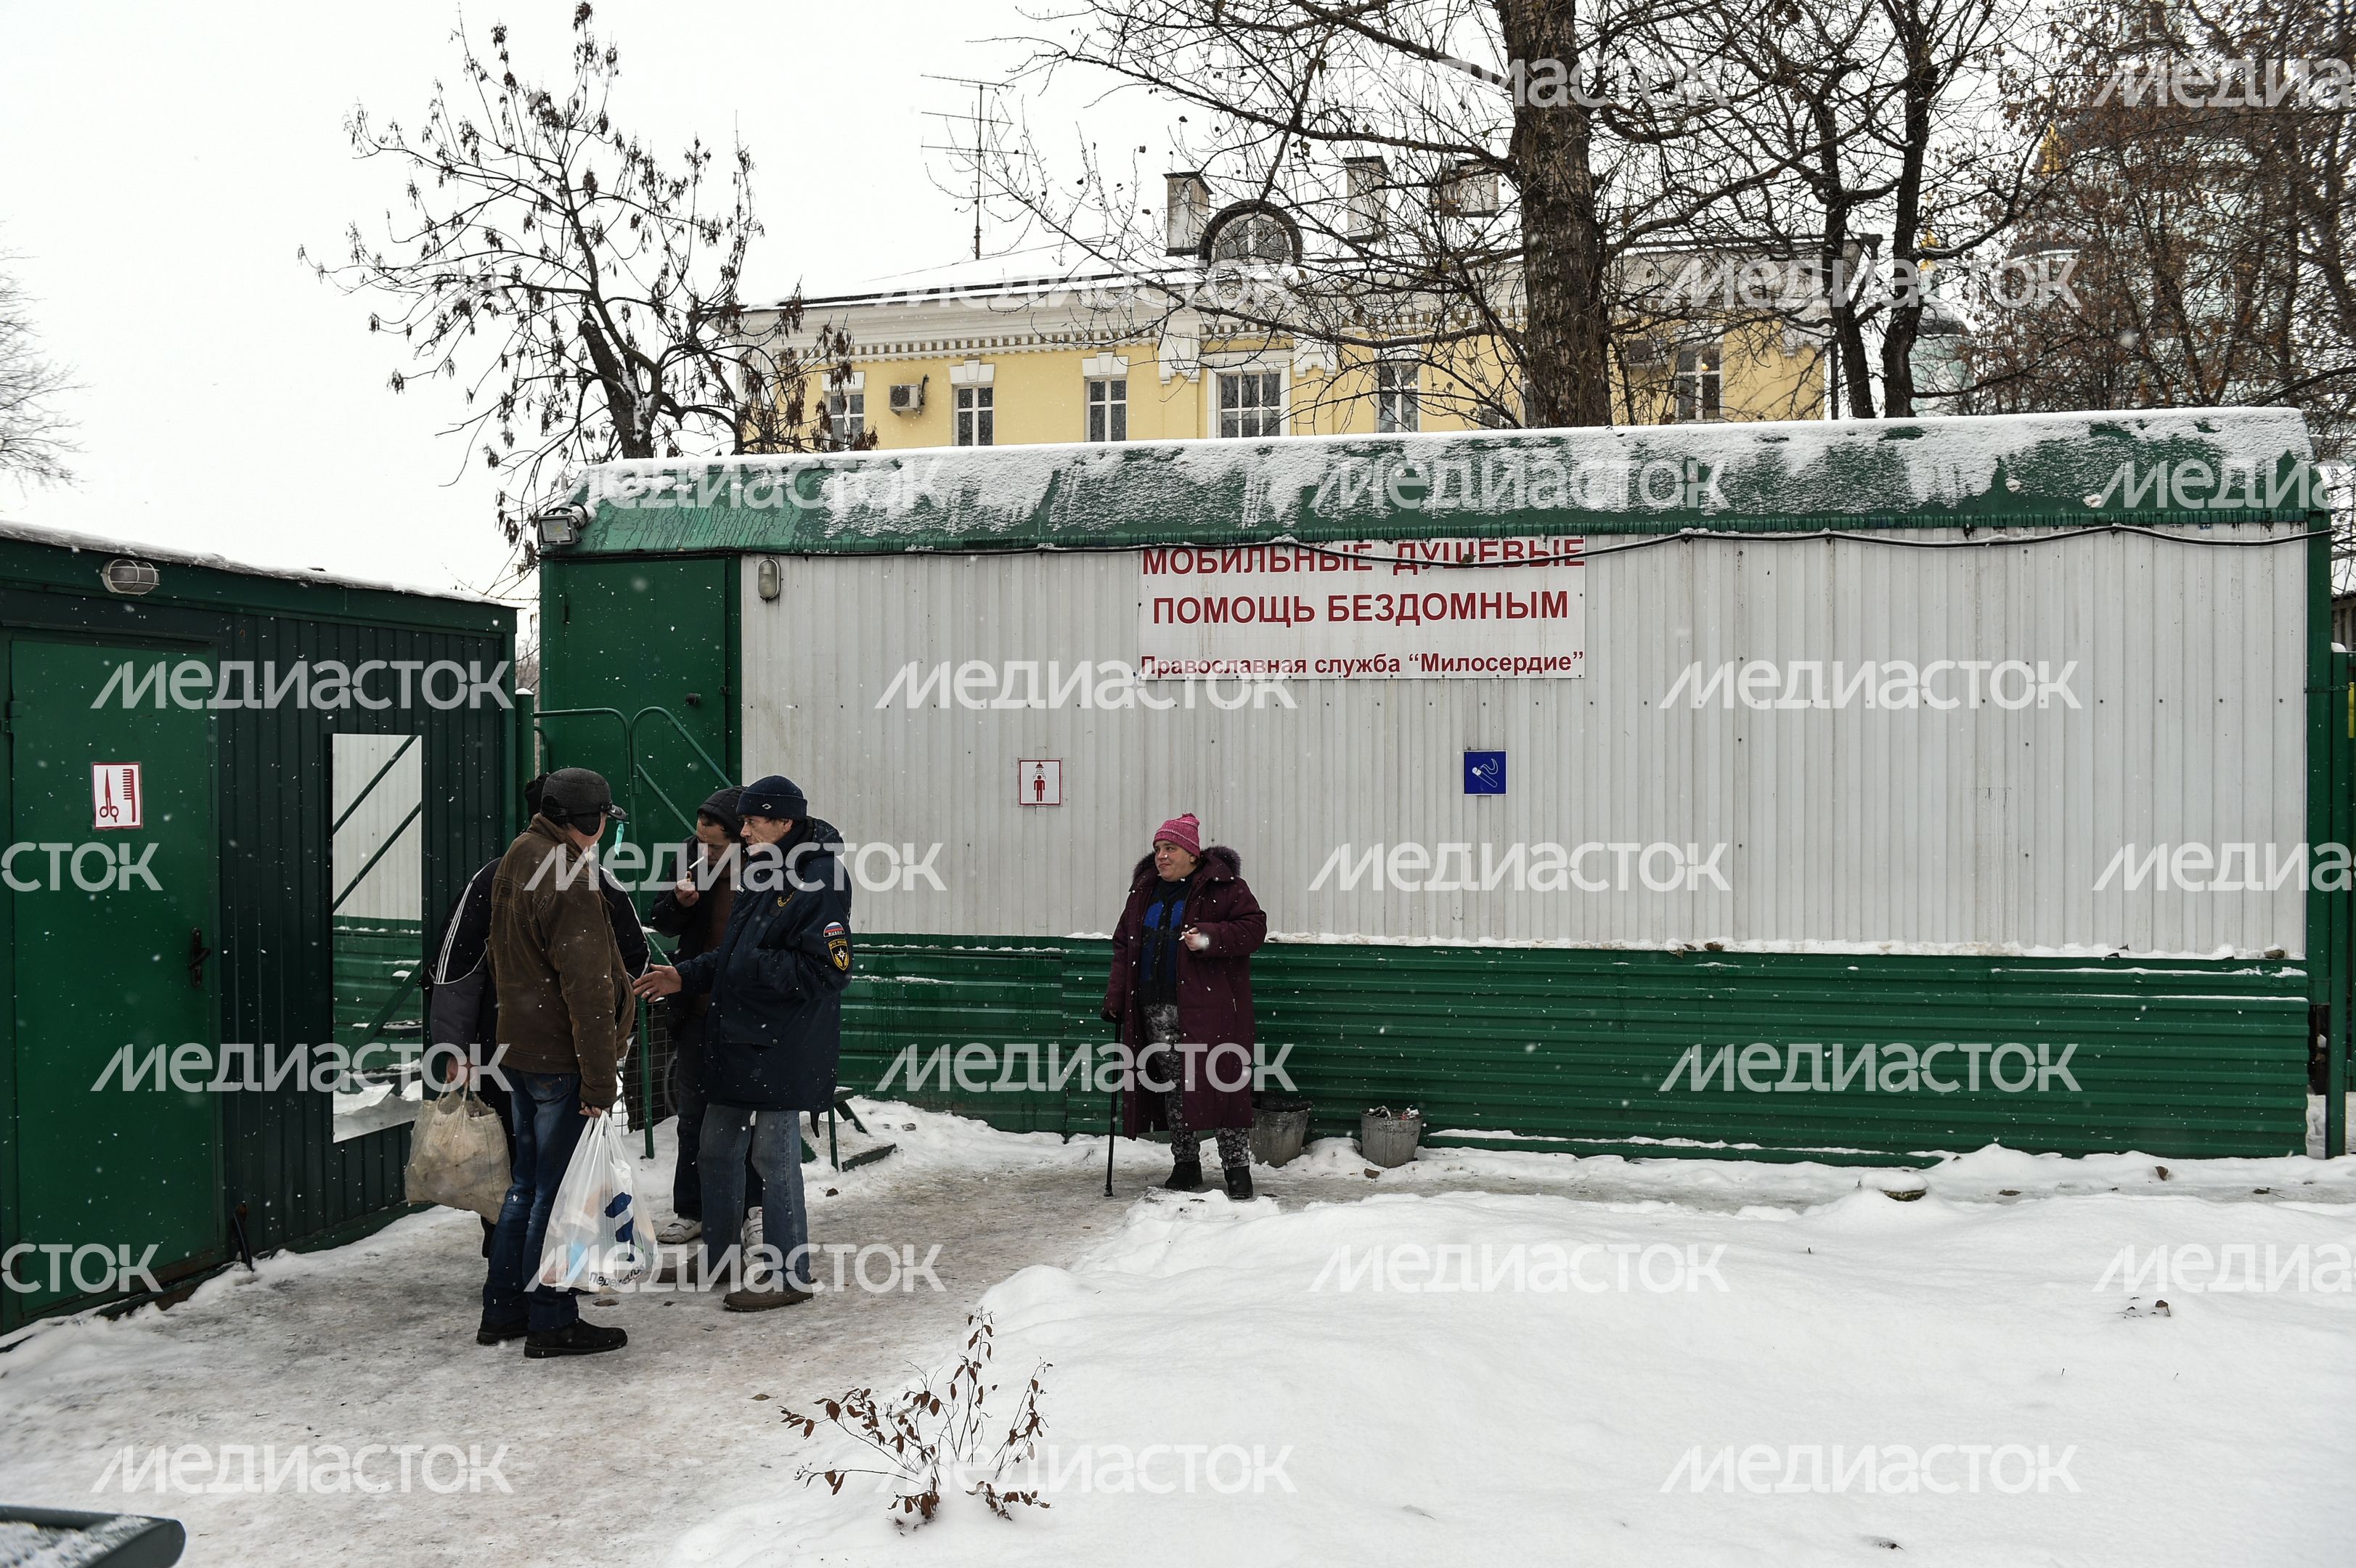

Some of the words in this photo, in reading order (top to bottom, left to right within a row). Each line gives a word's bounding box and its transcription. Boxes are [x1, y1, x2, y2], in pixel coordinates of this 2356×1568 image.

[1142, 544, 1373, 575] МОБИЛЬНЫЕ
[1393, 538, 1585, 576] ДУШЕВЫЕ
[1152, 595, 1316, 628] ПОМОЩЬ
[1327, 590, 1569, 626] БЕЗДОМНЫМ
[1141, 656, 1307, 679] Православная
[1313, 653, 1401, 678] служба
